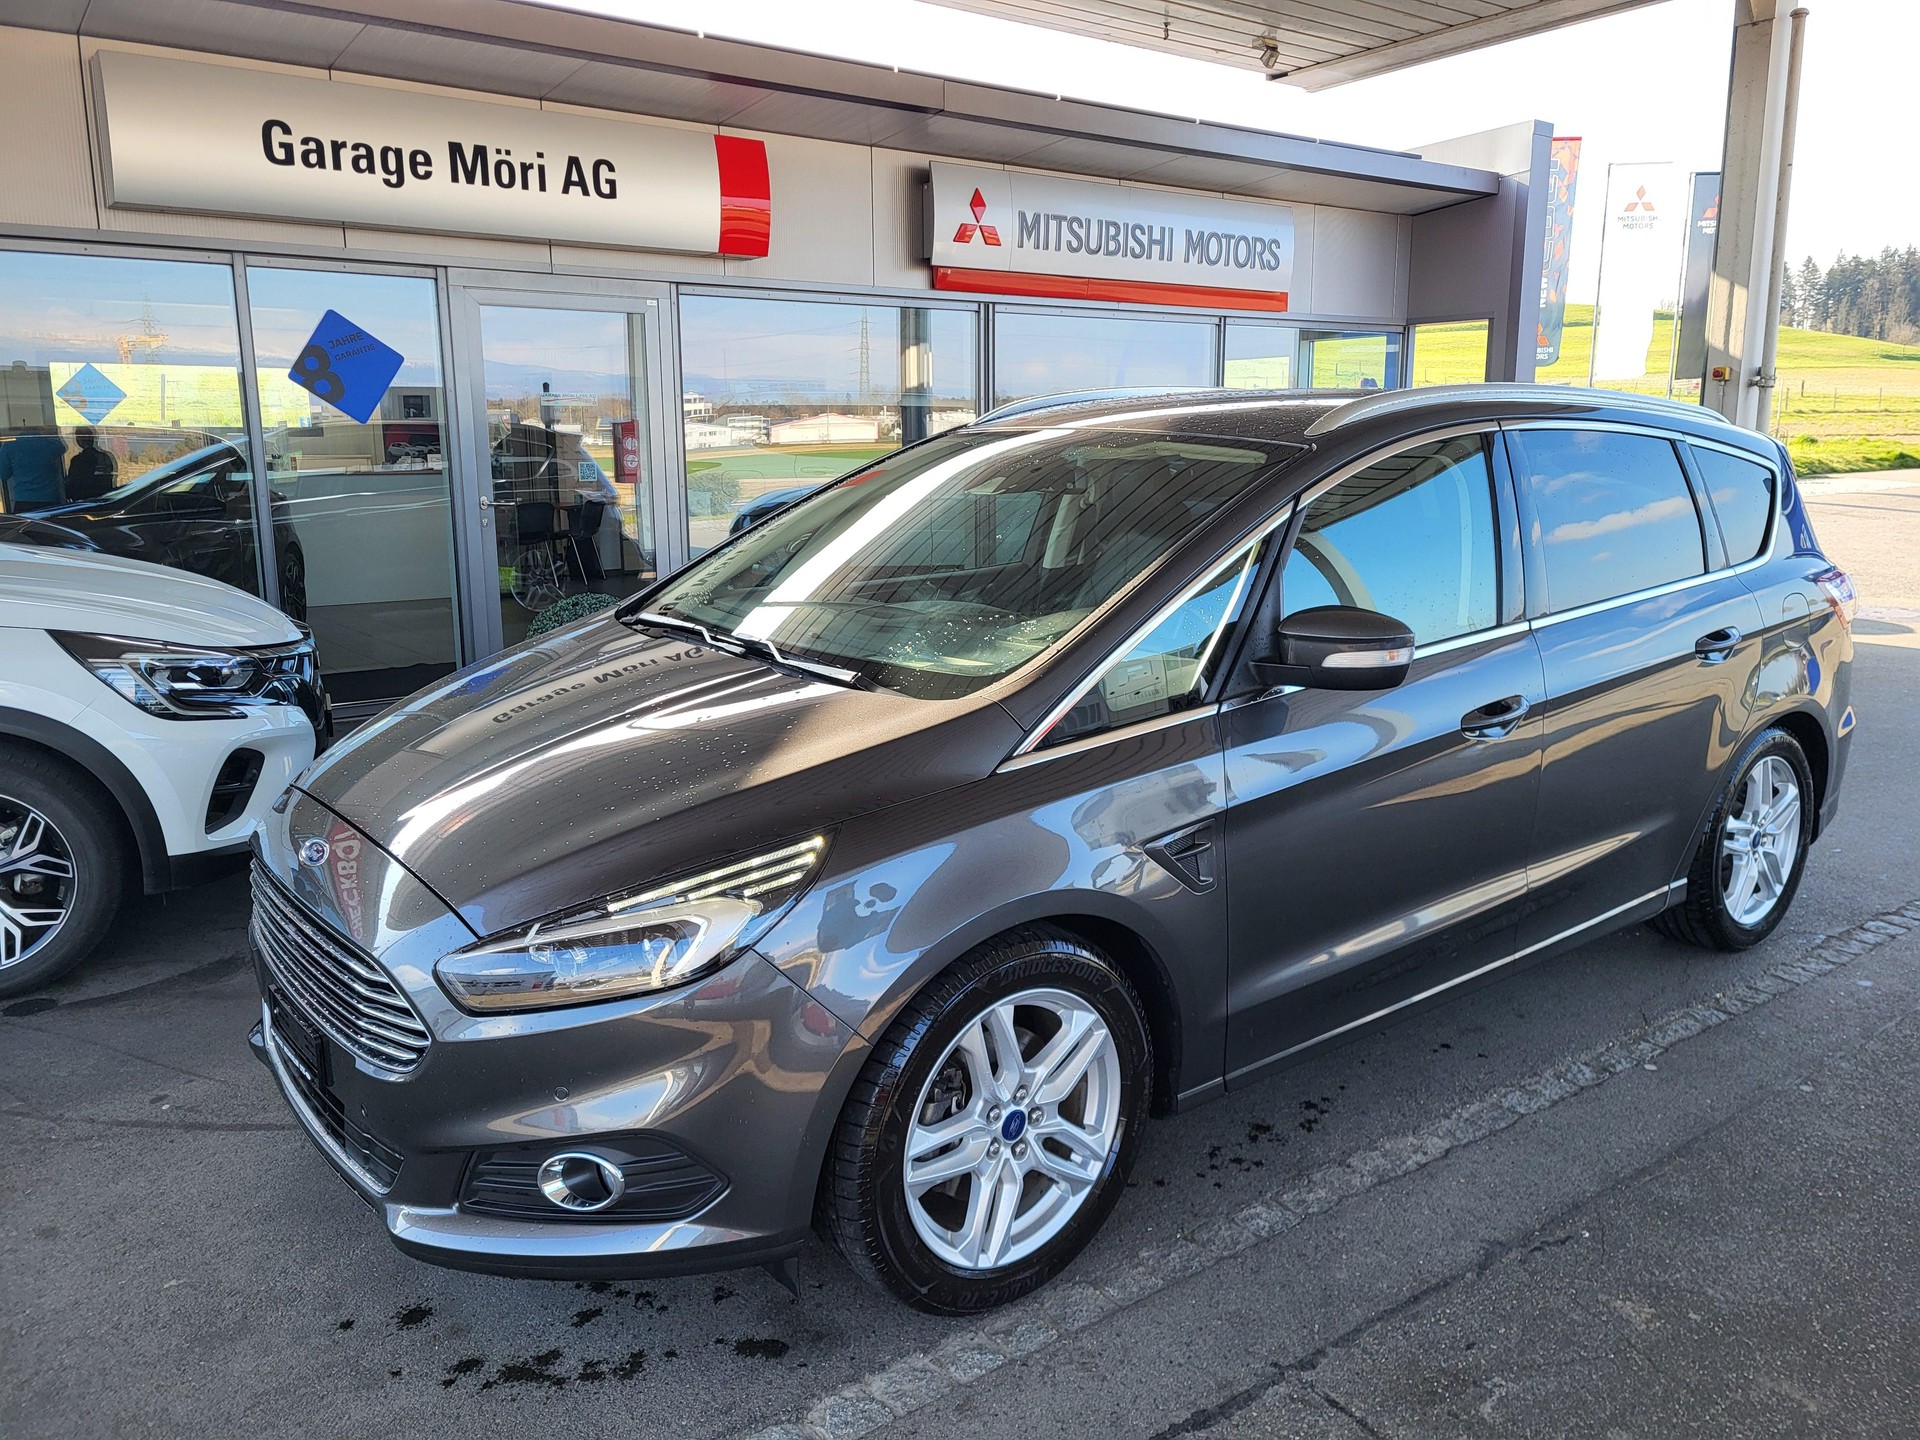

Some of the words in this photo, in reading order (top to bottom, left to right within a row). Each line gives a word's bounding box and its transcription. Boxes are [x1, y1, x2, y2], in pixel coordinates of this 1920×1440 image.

[261, 119, 433, 188] Garage
[448, 140, 547, 193] Möri
[561, 155, 618, 200] AG
[1617, 215, 1660, 223] MITSUBISH
[1623, 222, 1654, 230] MOTORS
[1017, 210, 1174, 262] MITSUBISHI
[1183, 229, 1281, 272] MOTORS
[328, 332, 364, 349] JAHRE
[334, 343, 376, 360] GARANTIE
[292, 345, 345, 405] 8
[1000, 958, 1105, 986] BRIDGESTONE
